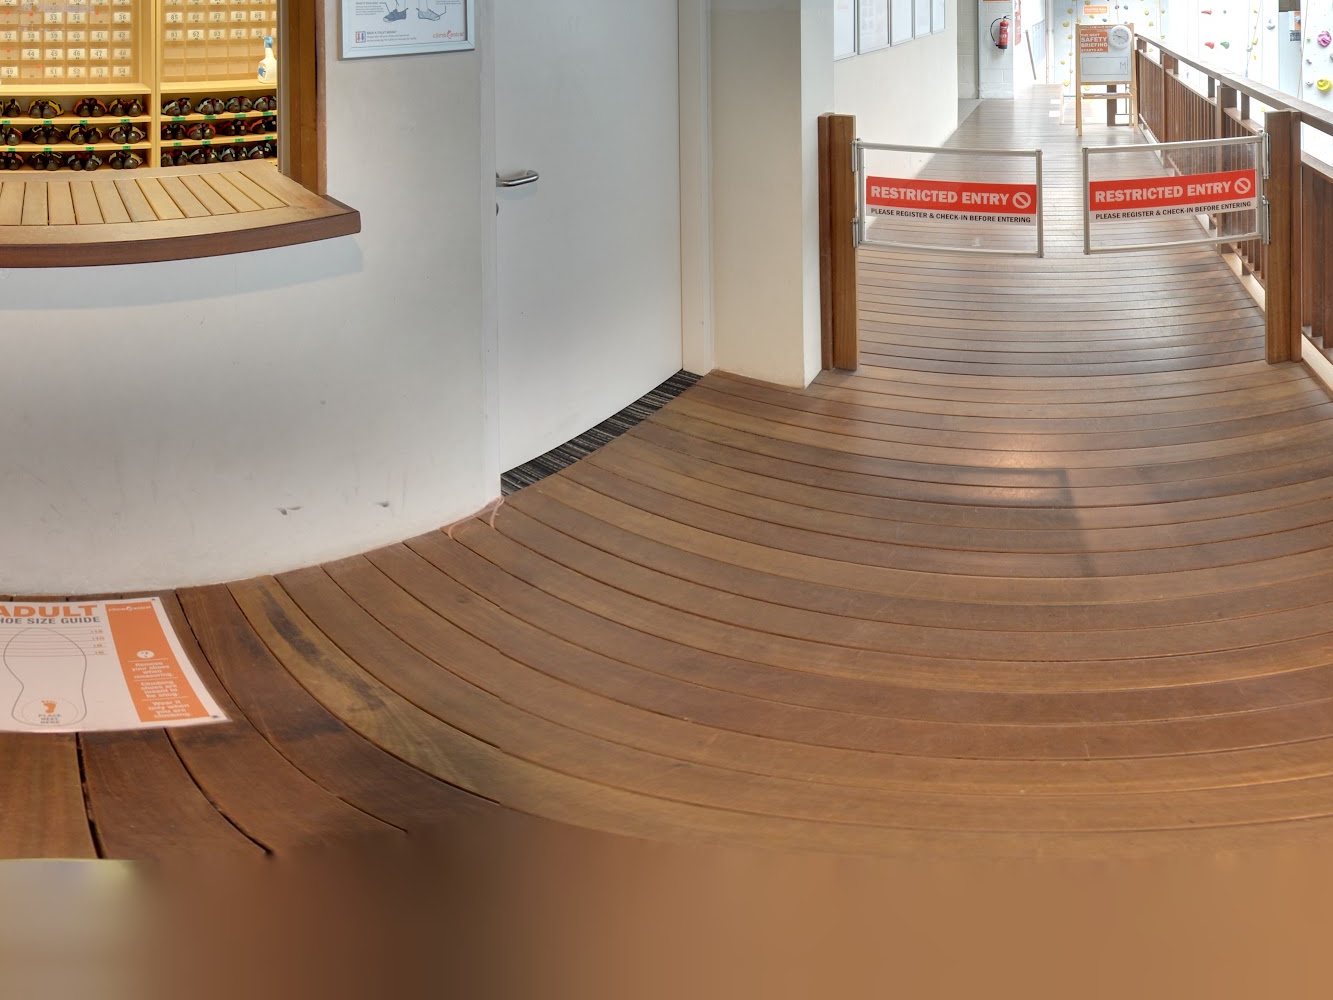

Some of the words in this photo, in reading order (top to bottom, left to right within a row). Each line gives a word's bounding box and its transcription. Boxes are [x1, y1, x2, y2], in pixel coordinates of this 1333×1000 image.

[871, 186, 957, 203] RESTRICTED
[962, 192, 1009, 205] ENTRY
[1096, 186, 1183, 202] RESTRICTED
[1187, 181, 1231, 196] ENTRY
[1163, 207, 1193, 215] CHECK-IN
[1221, 201, 1251, 210] ENTERING
[61, 616, 100, 624] GUIDE
